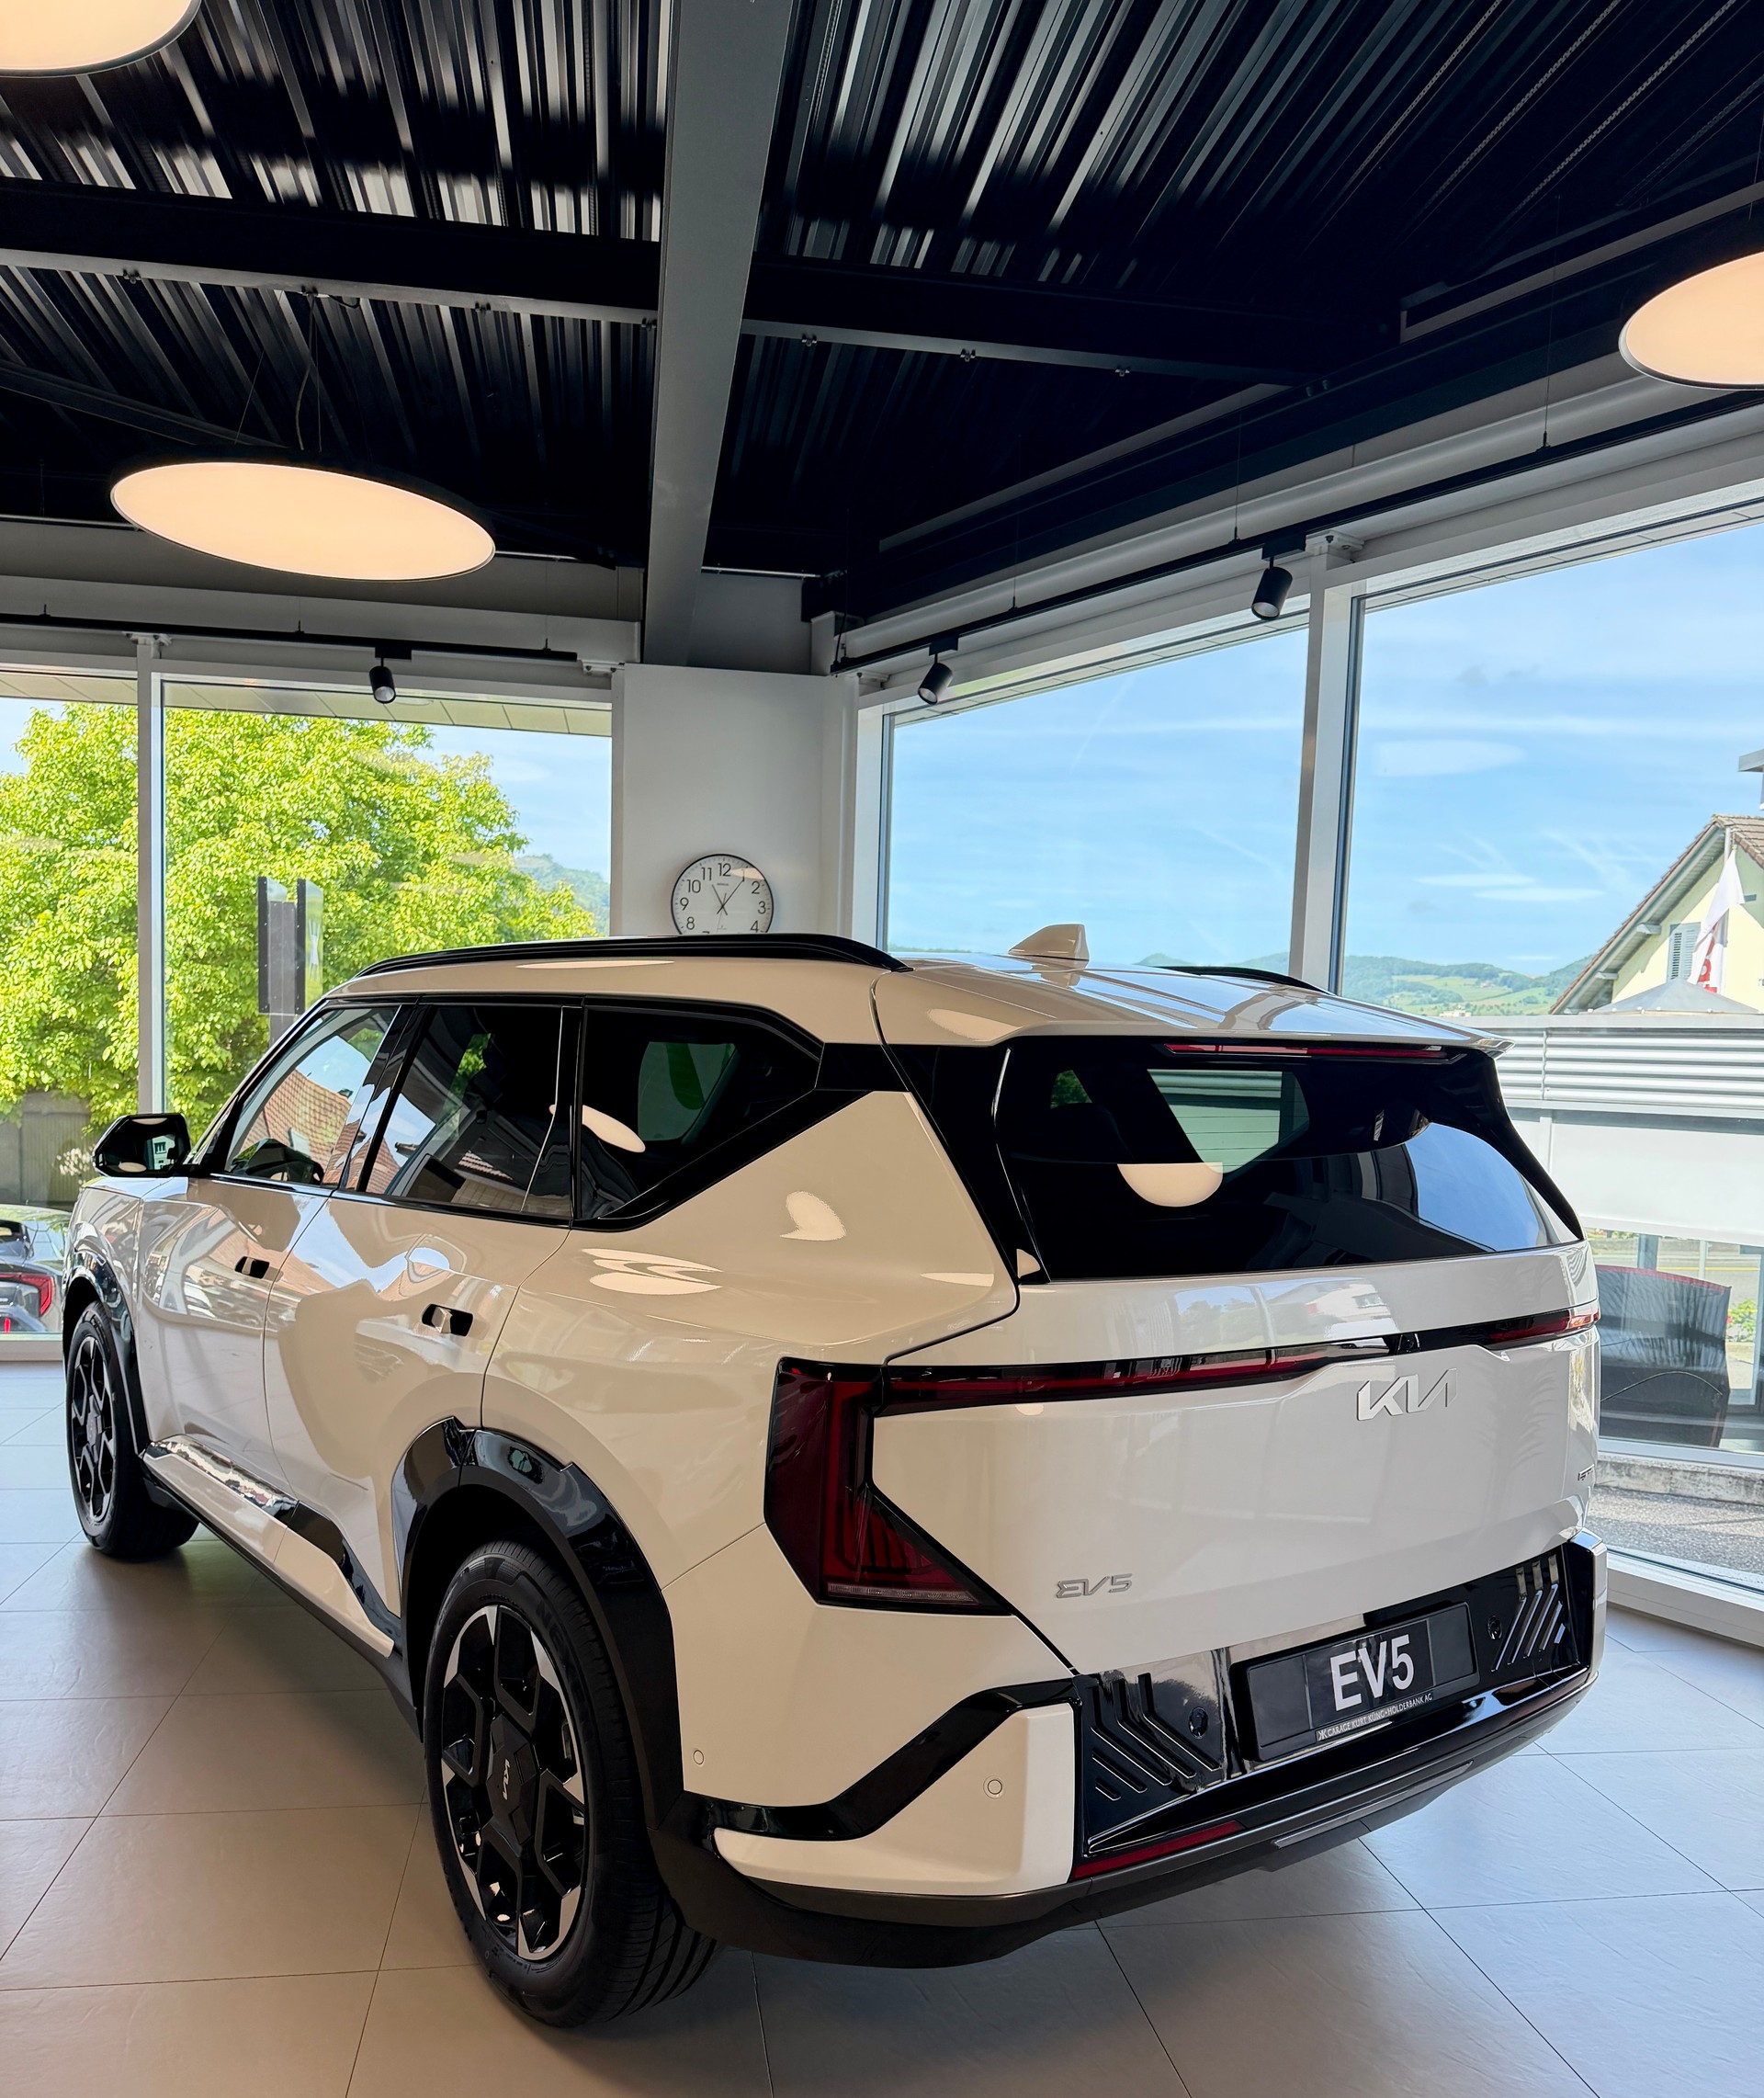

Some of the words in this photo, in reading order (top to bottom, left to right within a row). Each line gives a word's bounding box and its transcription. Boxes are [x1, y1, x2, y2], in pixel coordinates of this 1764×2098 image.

[701, 867, 712, 881] 11
[718, 863, 731, 877] 12
[686, 879, 701, 893] 10
[752, 881, 761, 894] 2
[680, 897, 689, 911] 9
[758, 901, 766, 914] 3
[686, 916, 695, 930] 8
[751, 920, 759, 933] 4
[1356, 1367, 1457, 1421] KIA
[1056, 1573, 1133, 1598] EV5
[1330, 1634, 1415, 1711] EV5
[1327, 1722, 1351, 1737] GARAGE
